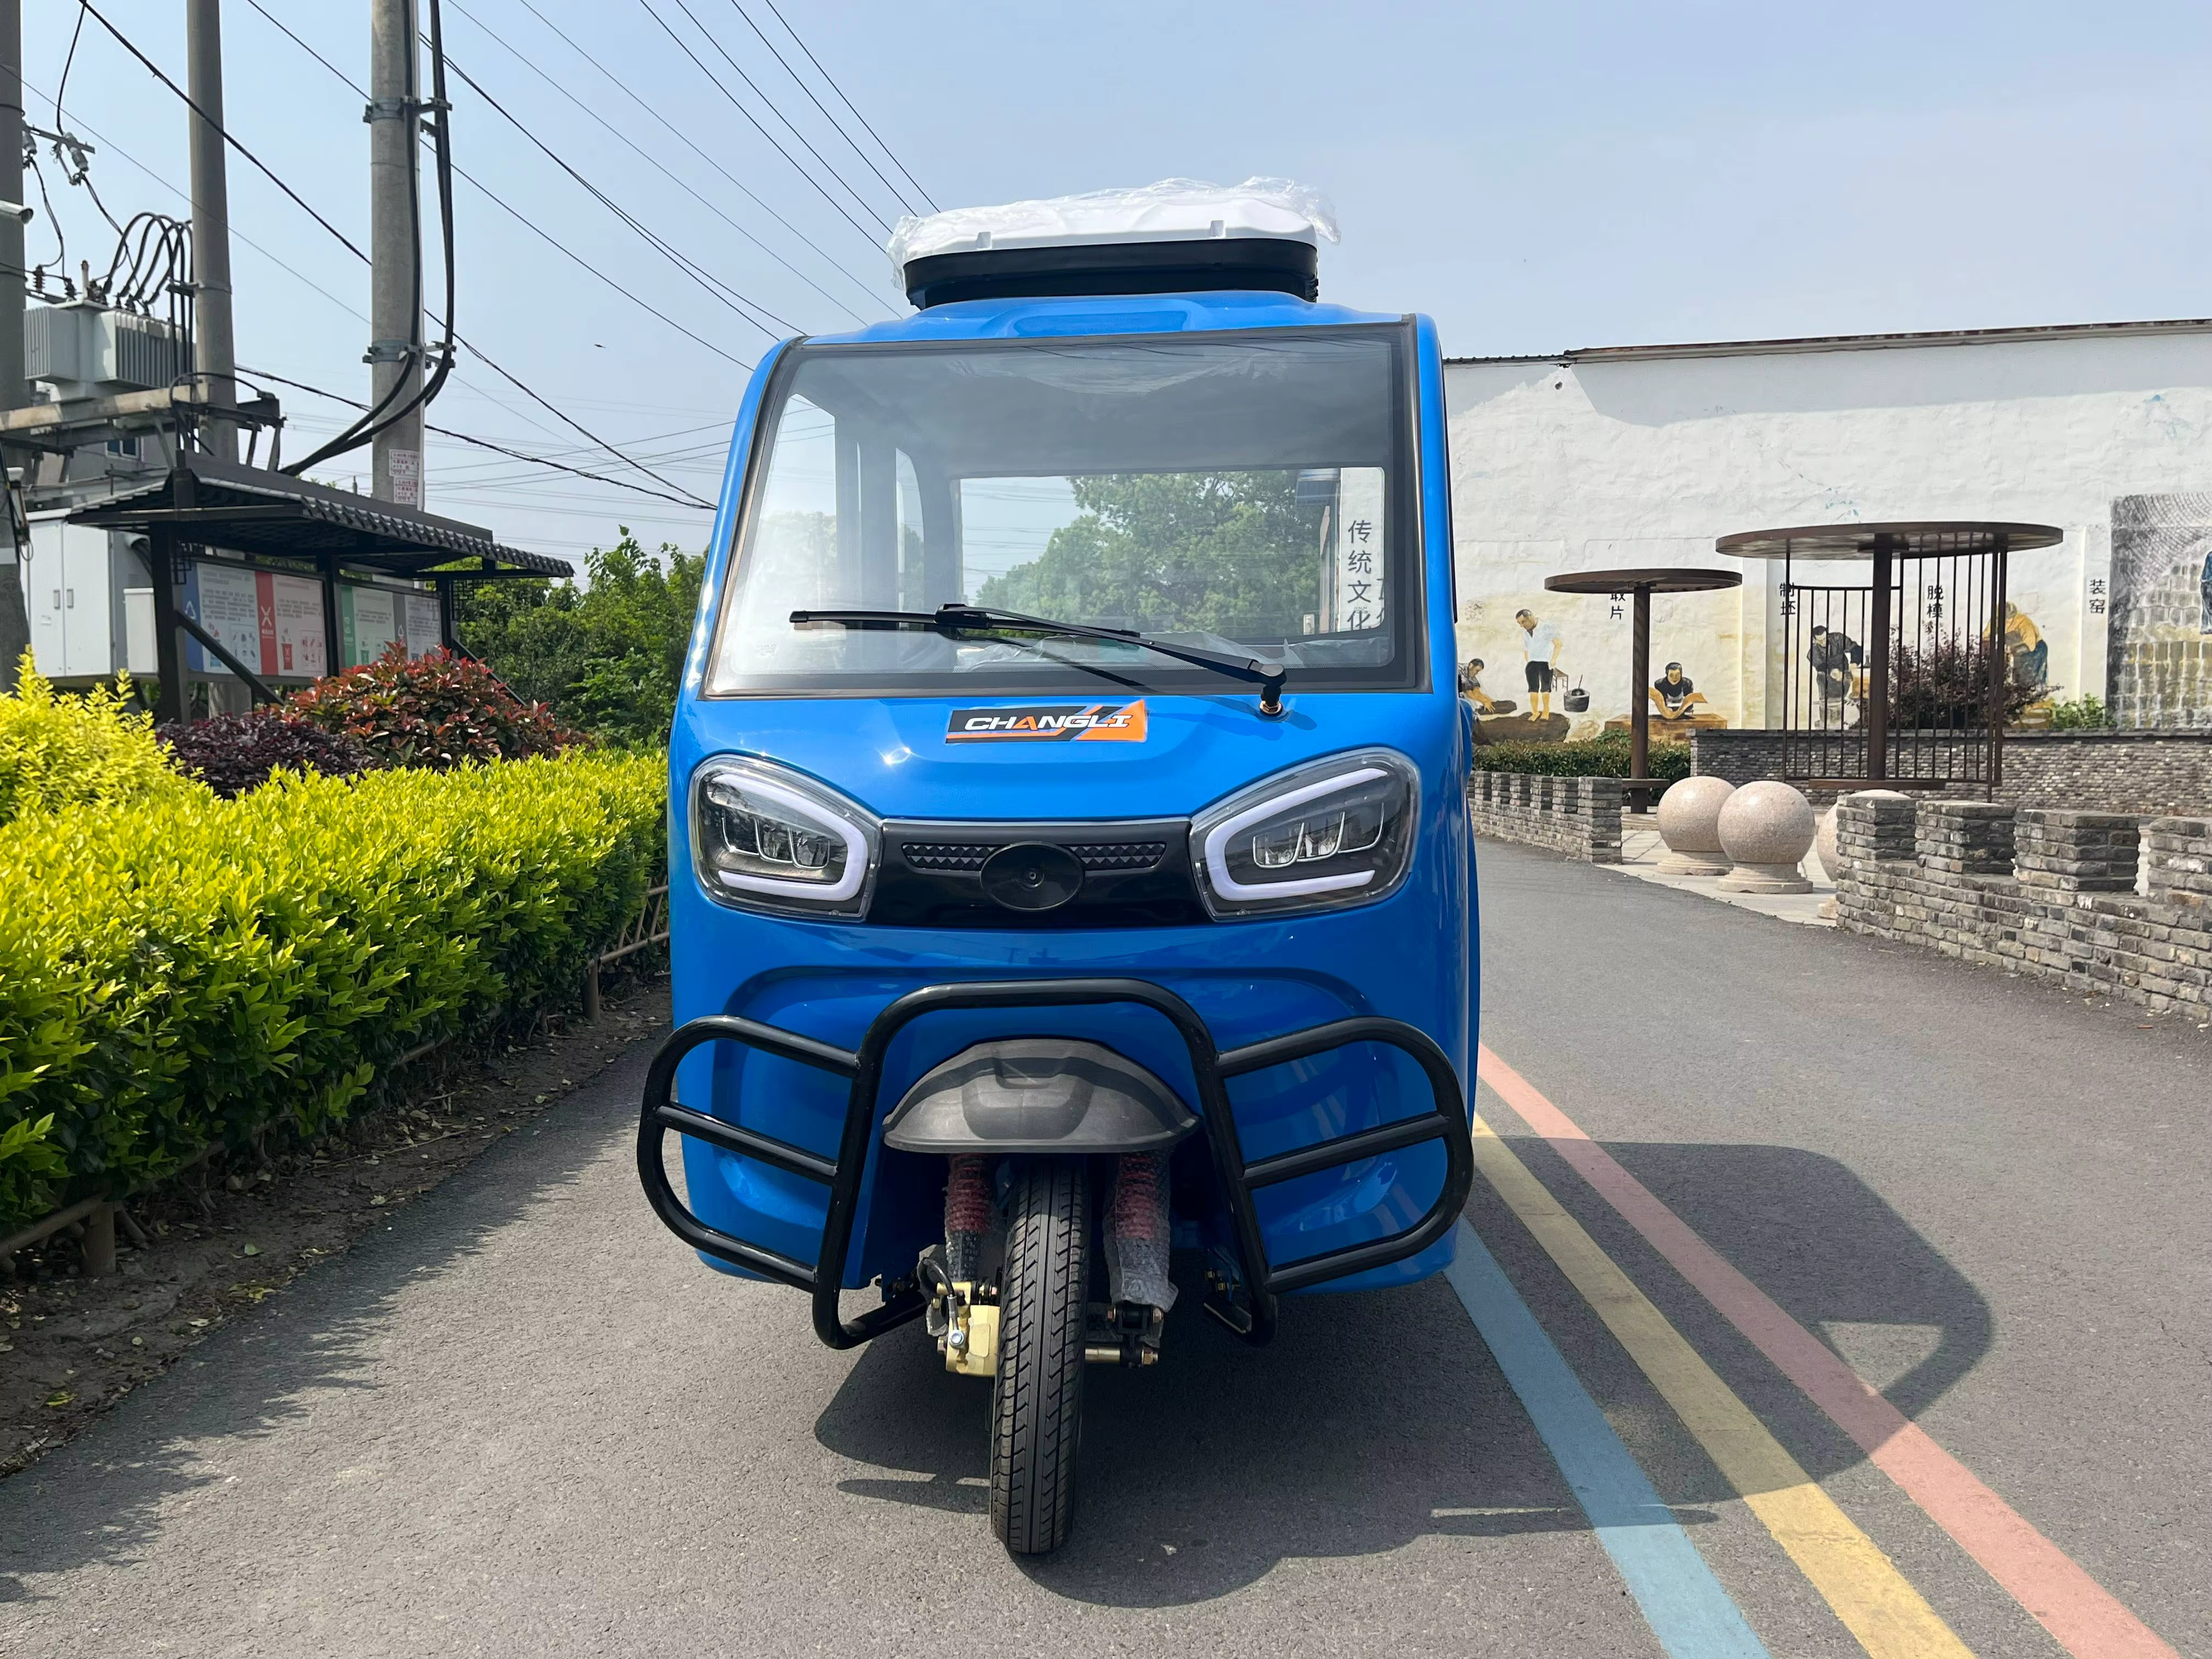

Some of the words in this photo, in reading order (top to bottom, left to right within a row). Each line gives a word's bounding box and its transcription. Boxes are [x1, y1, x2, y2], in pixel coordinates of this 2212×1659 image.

[1347, 520, 1372, 630] 传统文化
[1779, 582, 1796, 615] 制坯
[1927, 585, 1944, 618] 脱模
[2089, 579, 2106, 614] 装窑
[964, 714, 1133, 731] CHANGLI
